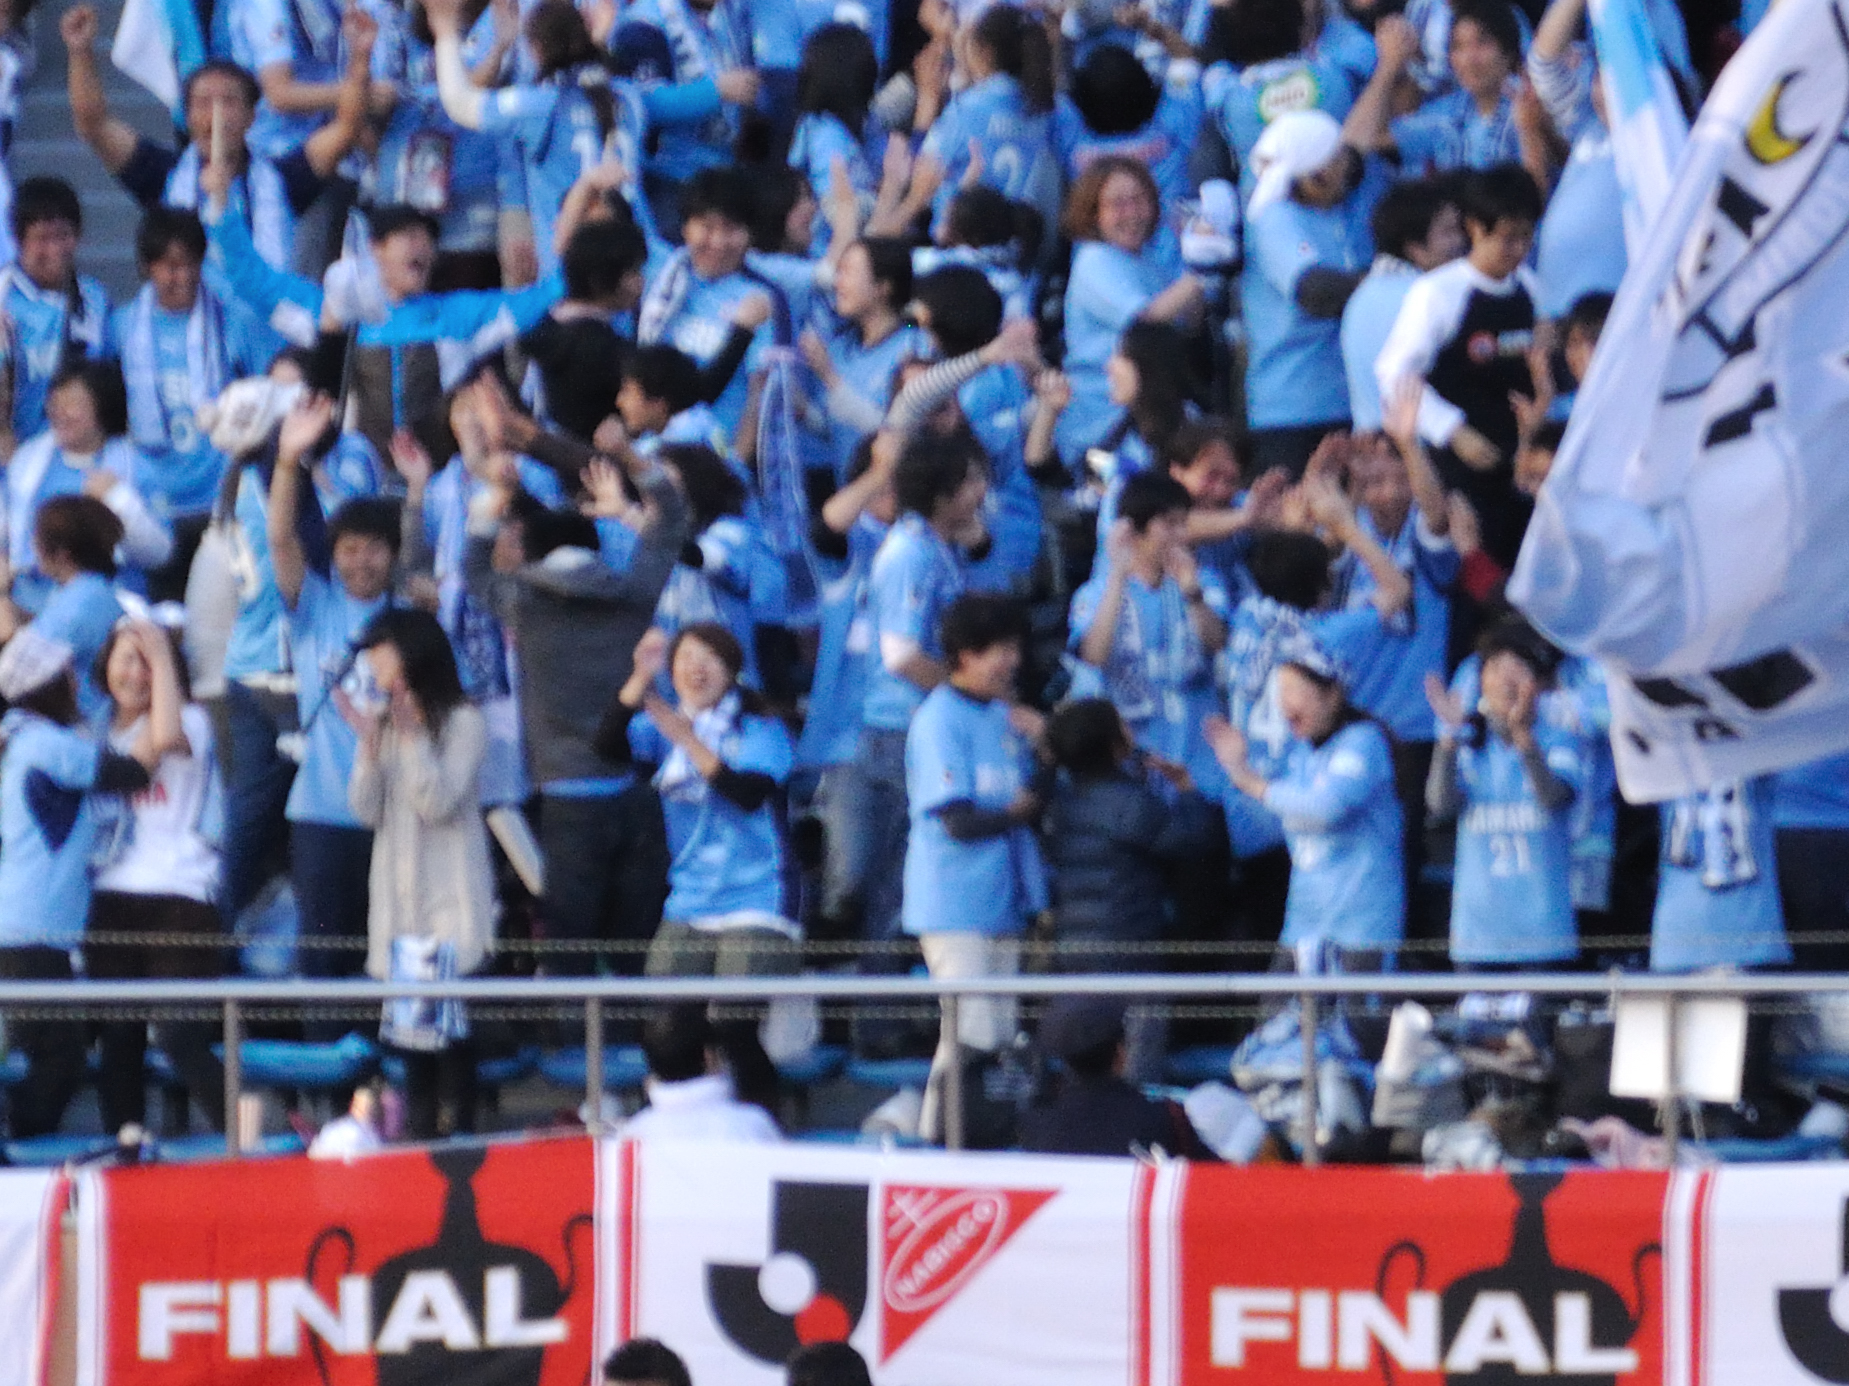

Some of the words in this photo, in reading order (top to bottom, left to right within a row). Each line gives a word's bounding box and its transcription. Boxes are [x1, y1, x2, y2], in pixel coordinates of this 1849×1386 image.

[894, 1200, 996, 1301] NABISCO
[138, 1266, 569, 1360] FINAL
[1210, 1286, 1639, 1374] FINAL
